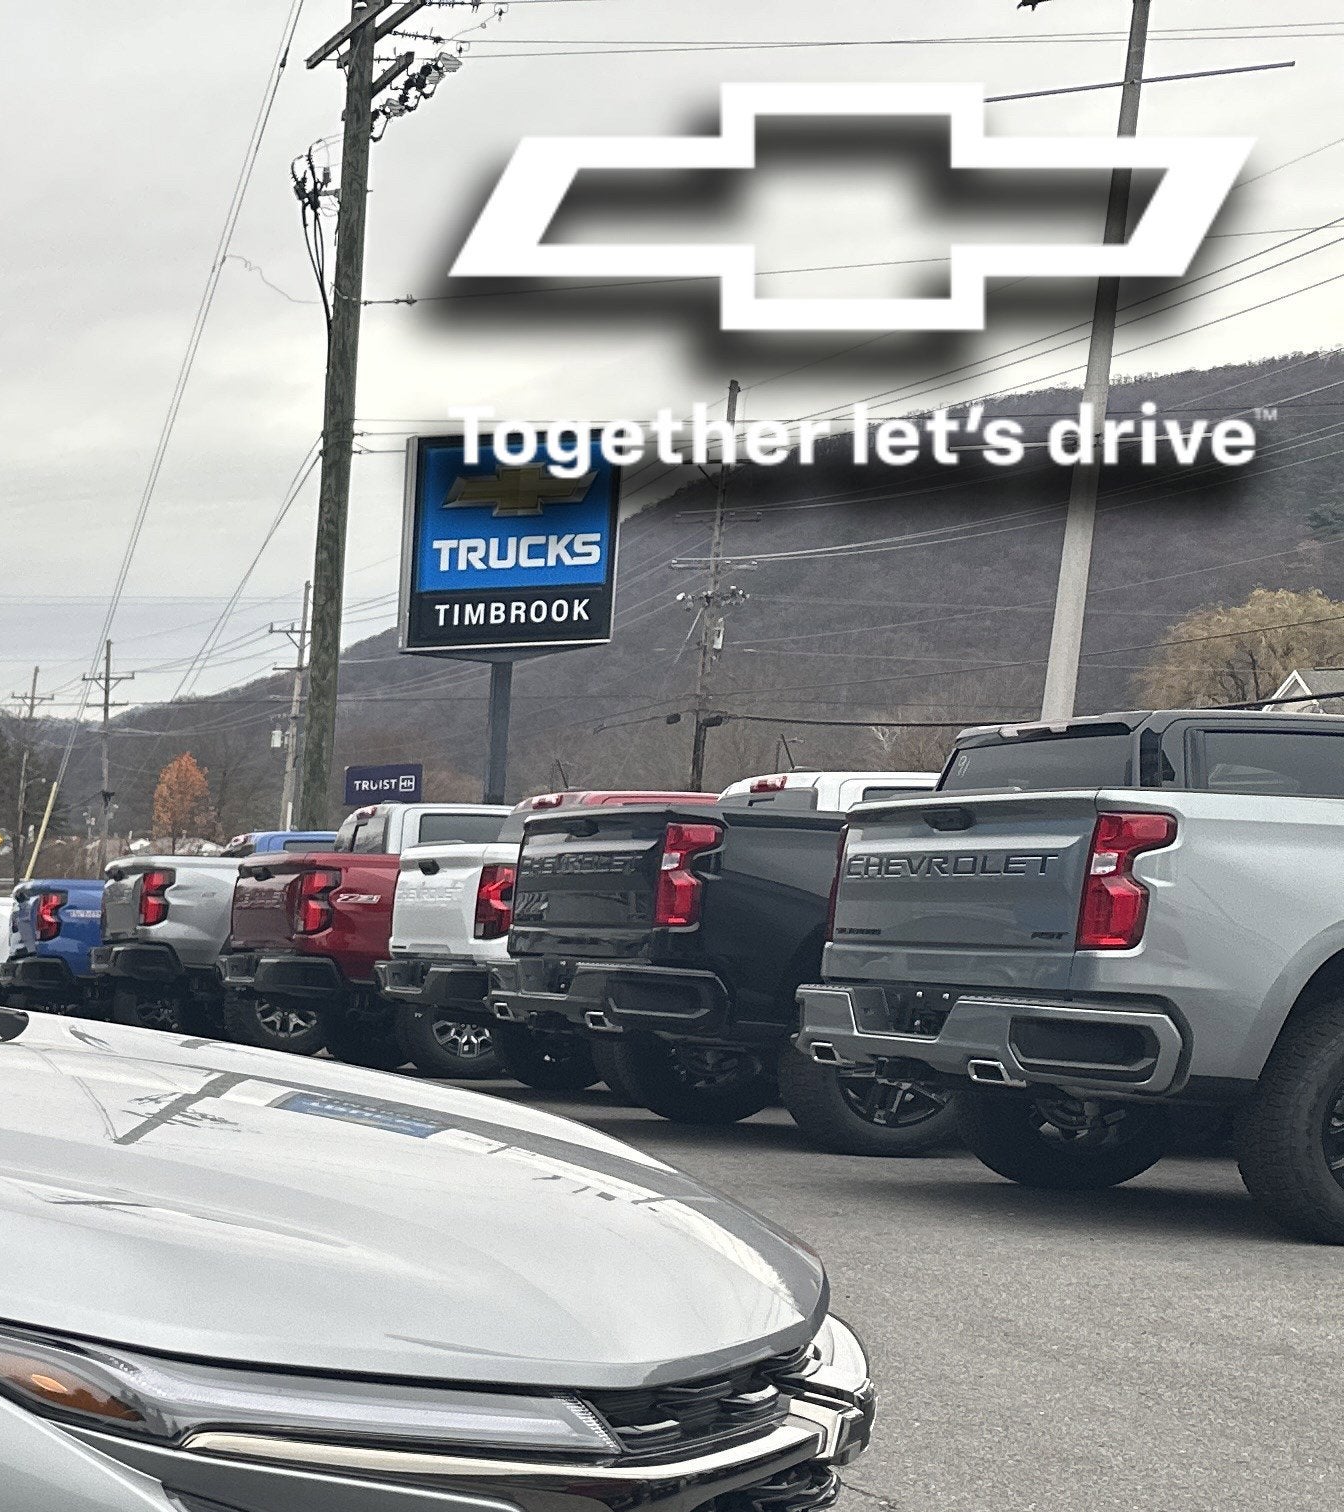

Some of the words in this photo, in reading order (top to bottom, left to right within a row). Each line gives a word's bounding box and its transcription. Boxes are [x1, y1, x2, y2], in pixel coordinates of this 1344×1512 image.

[433, 533, 601, 572] TRUCKS
[435, 599, 590, 626] TIMBROOK
[354, 778, 397, 791] TRUIST
[847, 854, 1059, 879] CHEVROLET
